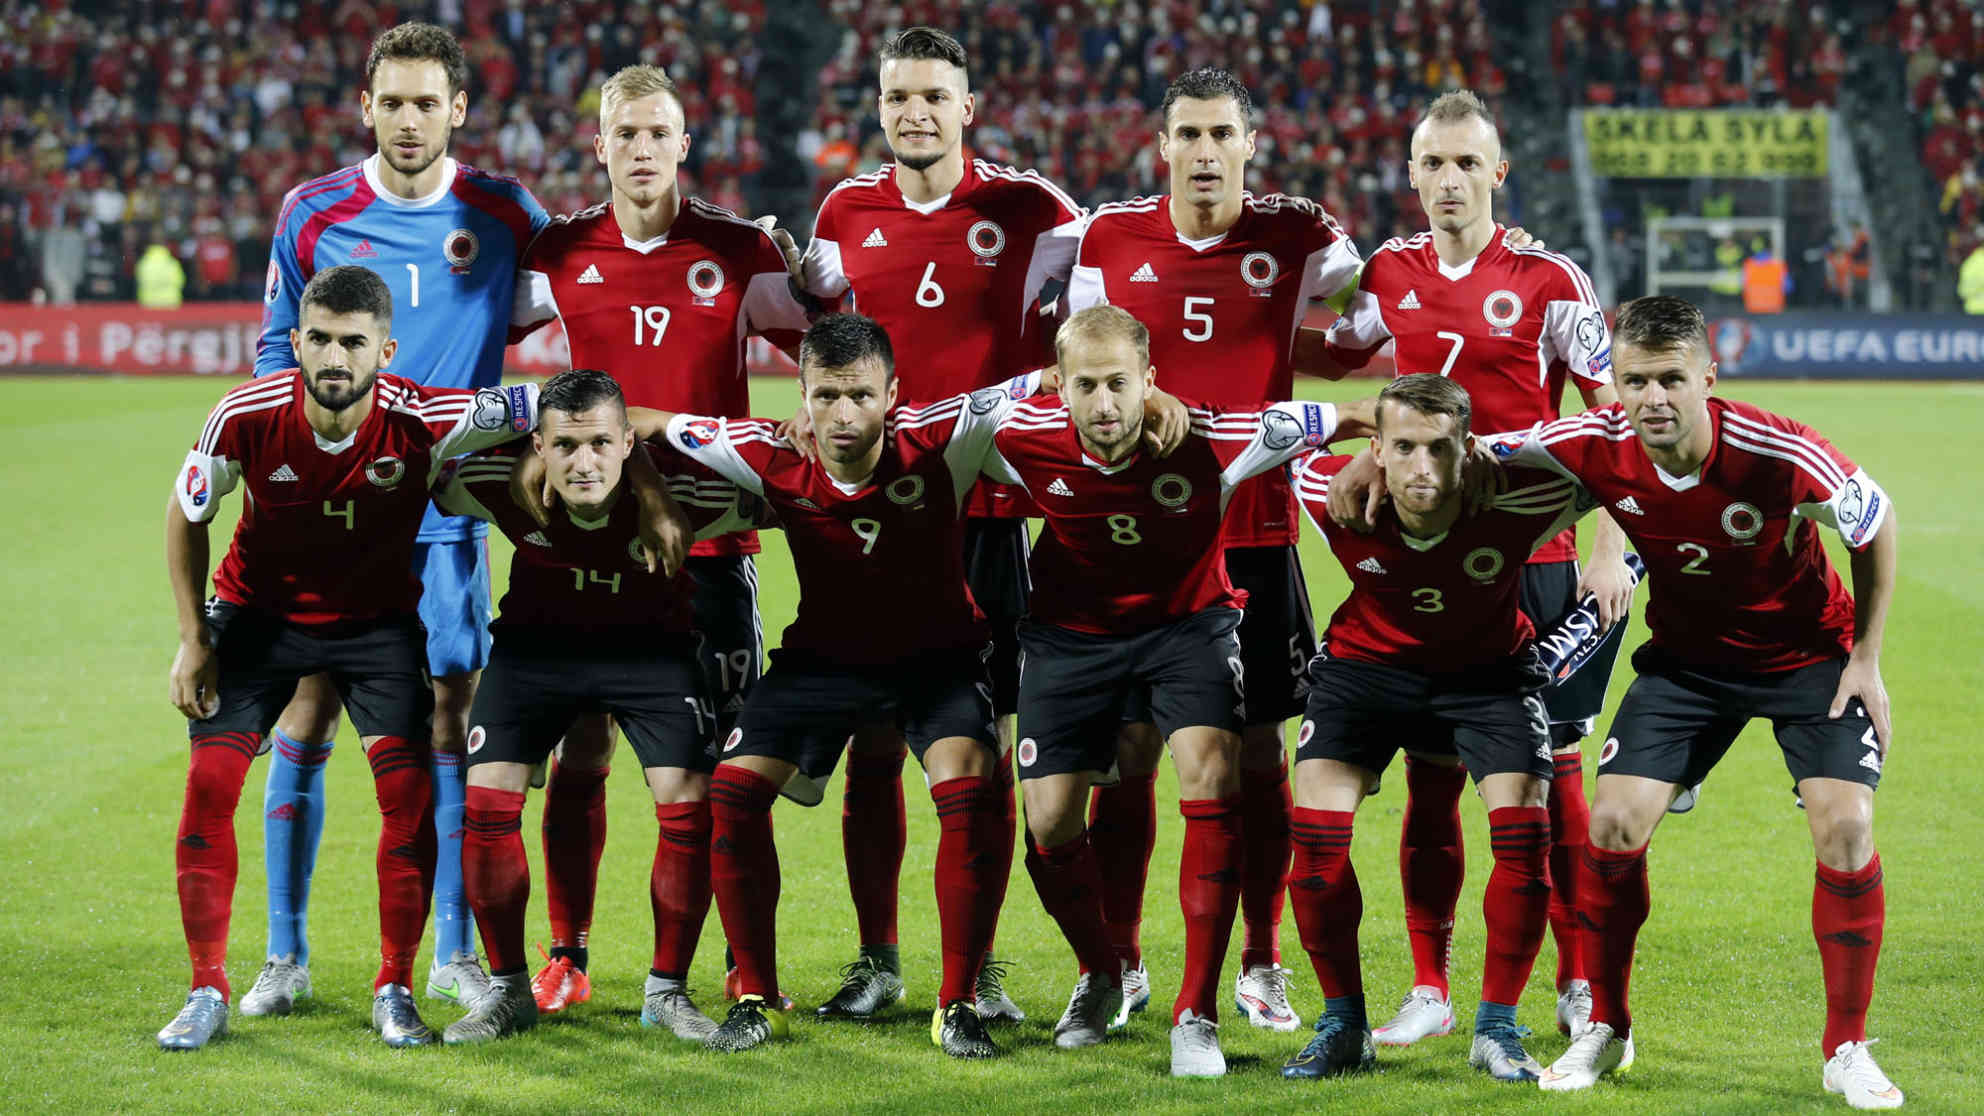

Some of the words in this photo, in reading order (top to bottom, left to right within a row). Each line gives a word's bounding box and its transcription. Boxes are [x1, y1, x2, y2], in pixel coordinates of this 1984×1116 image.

[1595, 115, 1709, 142] SKELA
[1726, 116, 1815, 142] SYLA
[406, 263, 419, 308] 1
[915, 261, 945, 308] 6
[629, 305, 671, 347] 19
[1182, 296, 1215, 343] 5
[63, 322, 79, 365] i
[1436, 330, 1465, 378] 7
[1772, 329, 1888, 363] UEFA
[1893, 329, 1984, 363] EUR
[322, 500, 355, 530] 4
[1106, 513, 1143, 545] 8
[851, 518, 881, 554] 9
[1676, 542, 1712, 575] 2
[569, 567, 622, 594] 14
[1411, 587, 1445, 613] 3
[713, 648, 752, 692] 19
[1523, 696, 1550, 735] 3
